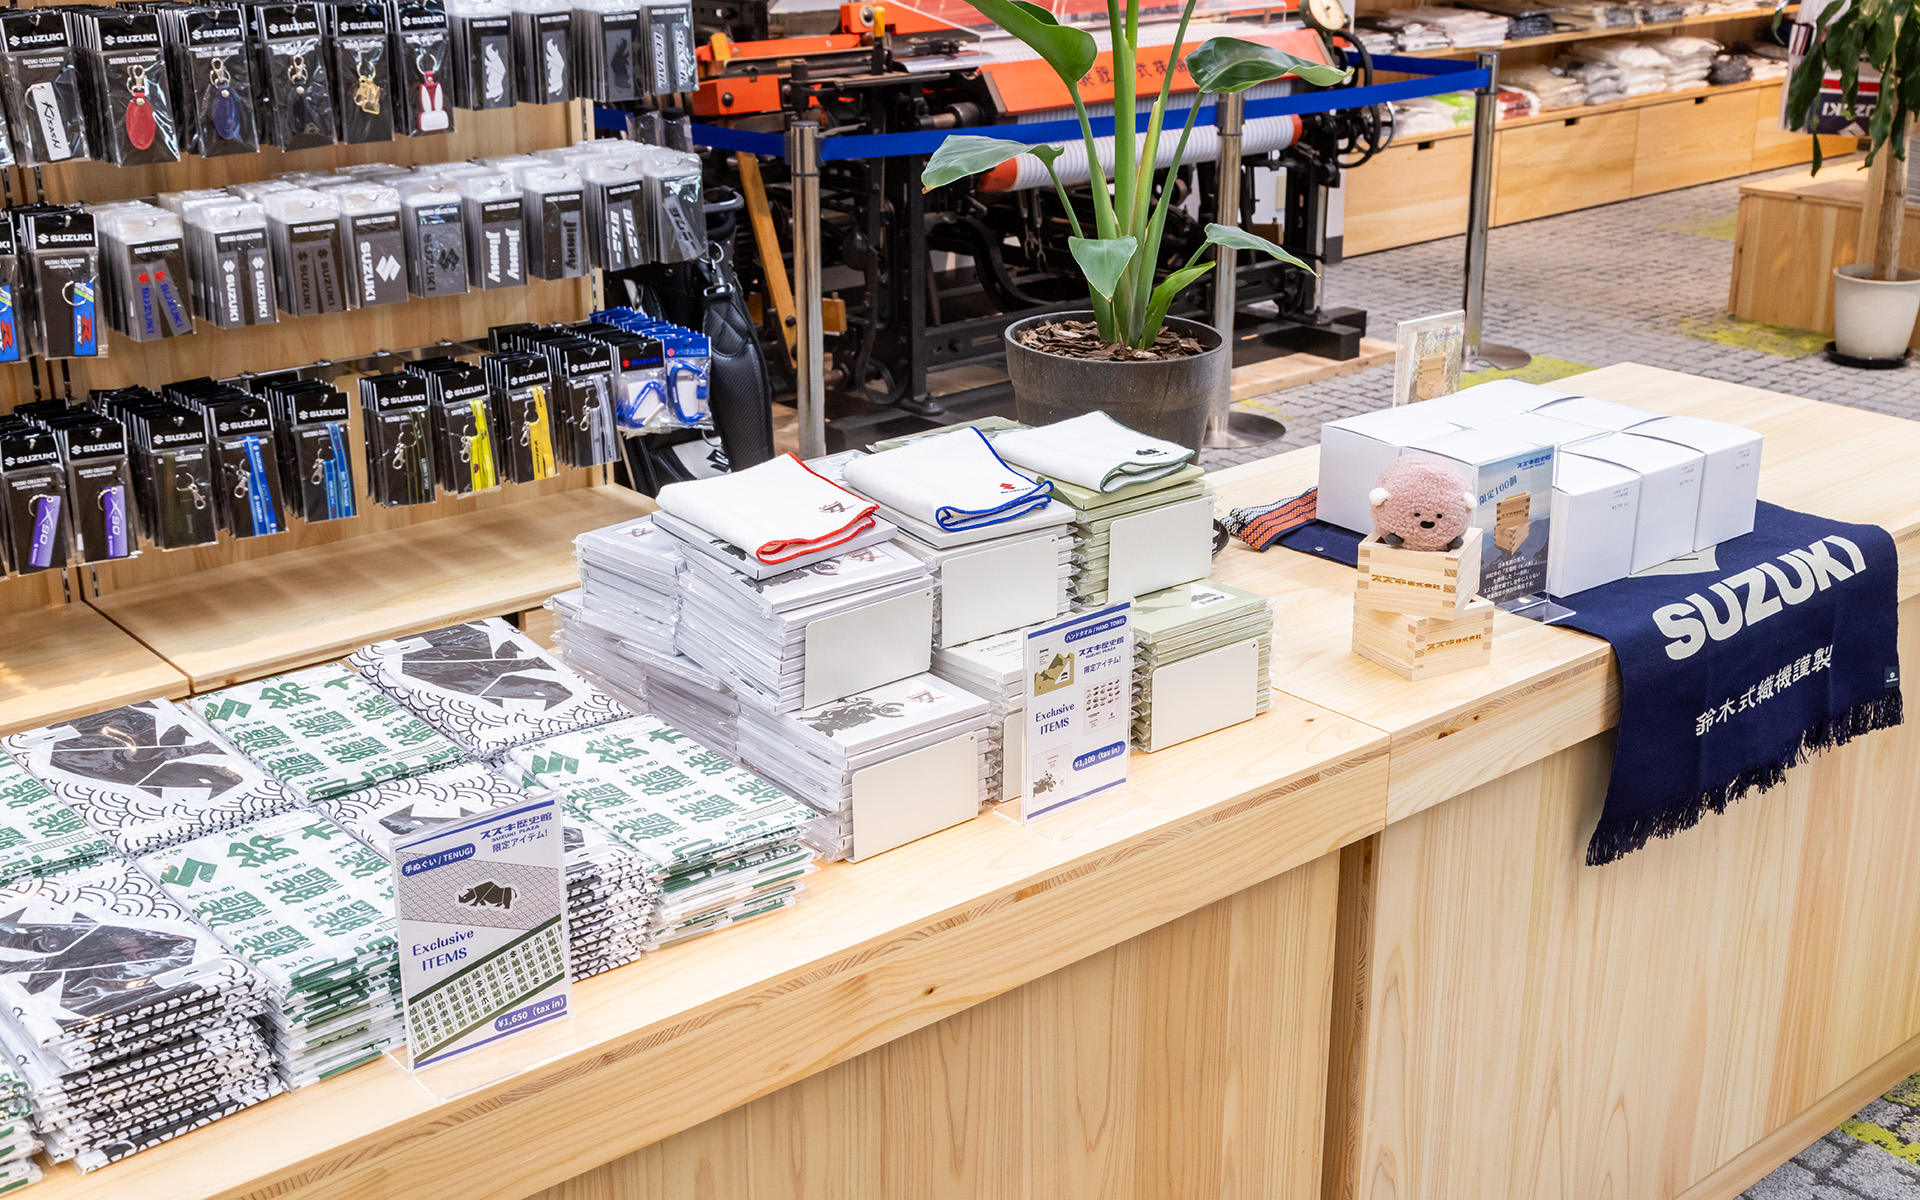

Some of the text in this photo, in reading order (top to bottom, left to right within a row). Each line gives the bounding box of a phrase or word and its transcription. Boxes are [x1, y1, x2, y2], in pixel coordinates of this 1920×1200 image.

[279, 21, 316, 32] SUZUKI
[350, 21, 384, 30] SUZUKI
[411, 15, 445, 24] SUZUKI
[22, 33, 64, 44] SUZUKI
[117, 33, 157, 44] SUZUKI
[202, 27, 240, 38] SUZUKI
[50, 233, 92, 243] SUZUKI
[564, 221, 577, 270] Jimny
[485, 230, 501, 283] Jimny
[505, 228, 520, 280] Jimny
[360, 241, 376, 301] SUZUKI
[301, 265, 312, 310] SUZUKI
[320, 262, 335, 306] SUZUKI
[226, 274, 239, 322] SUZUKI
[255, 270, 268, 318] SUZUKI
[142, 287, 155, 334] SUZUKI
[160, 283, 183, 328] SUZUKI
[579, 360, 610, 371] SUZUKI
[631, 357, 661, 366] SUZUKI
[518, 371, 547, 383] SUZUKI
[390, 394, 425, 404] SUZUKI
[454, 384, 485, 396] SUZUKI
[309, 408, 346, 418] SUZUKI
[230, 418, 268, 430] SUZUKI
[164, 432, 202, 443] SUZUKI
[83, 442, 122, 453] SUZUKI
[16, 452, 56, 464] SUZUKI
[1479, 475, 1518, 506] 限定100個
[1652, 535, 1866, 660] SUZUKI
[1078, 636, 1125, 657] スズキ歴史館
[1102, 646, 1116, 654] PLAZA
[1695, 645, 1834, 737] 鈴木式織機謹製
[1035, 703, 1075, 722] Exclusive
[1040, 717, 1070, 735] ITEMS
[1074, 745, 1121, 769] ¥1,100 (tax in)
[480, 812, 553, 841] スズキ歴史館
[491, 824, 540, 843] SUZUKI PLAZA
[412, 929, 475, 957] Exclusive
[421, 946, 468, 972] ITEMS
[498, 998, 564, 1028] ¥1,650 (tax in)
